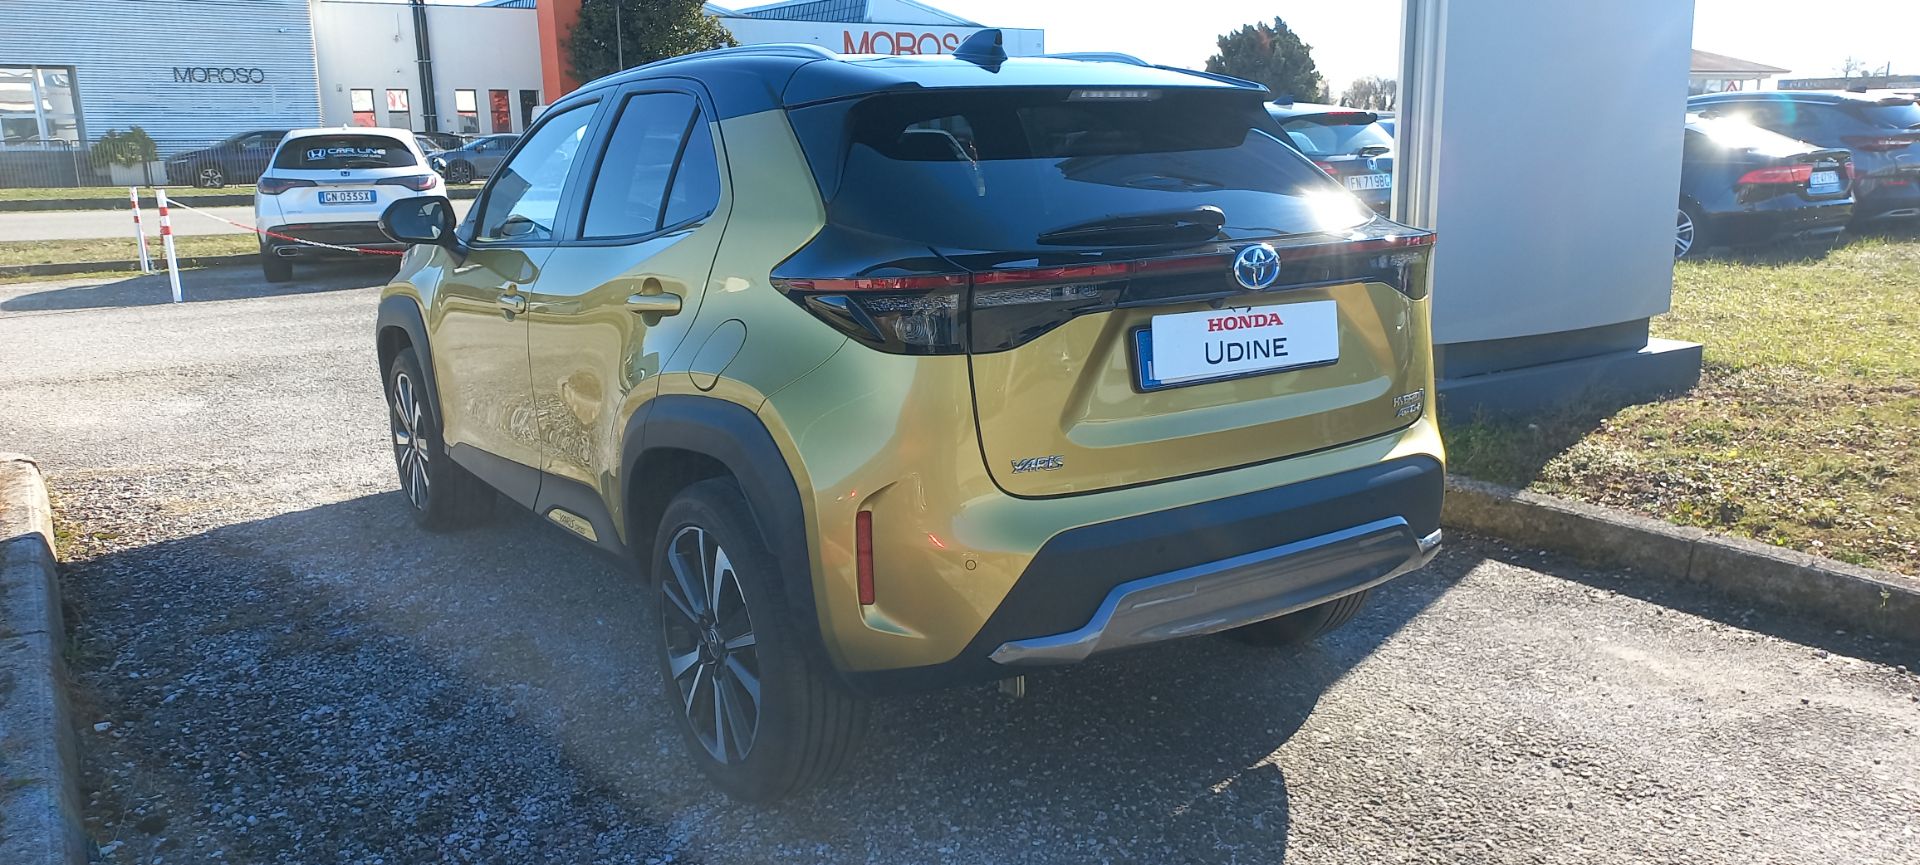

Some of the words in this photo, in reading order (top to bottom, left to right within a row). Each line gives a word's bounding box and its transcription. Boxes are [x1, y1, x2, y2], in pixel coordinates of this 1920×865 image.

[843, 30, 970, 55] MOROS
[173, 67, 265, 84] MOROSO
[1207, 313, 1284, 332] HONDA
[1205, 338, 1289, 365] UDINE
[1011, 455, 1064, 474] YARIS
